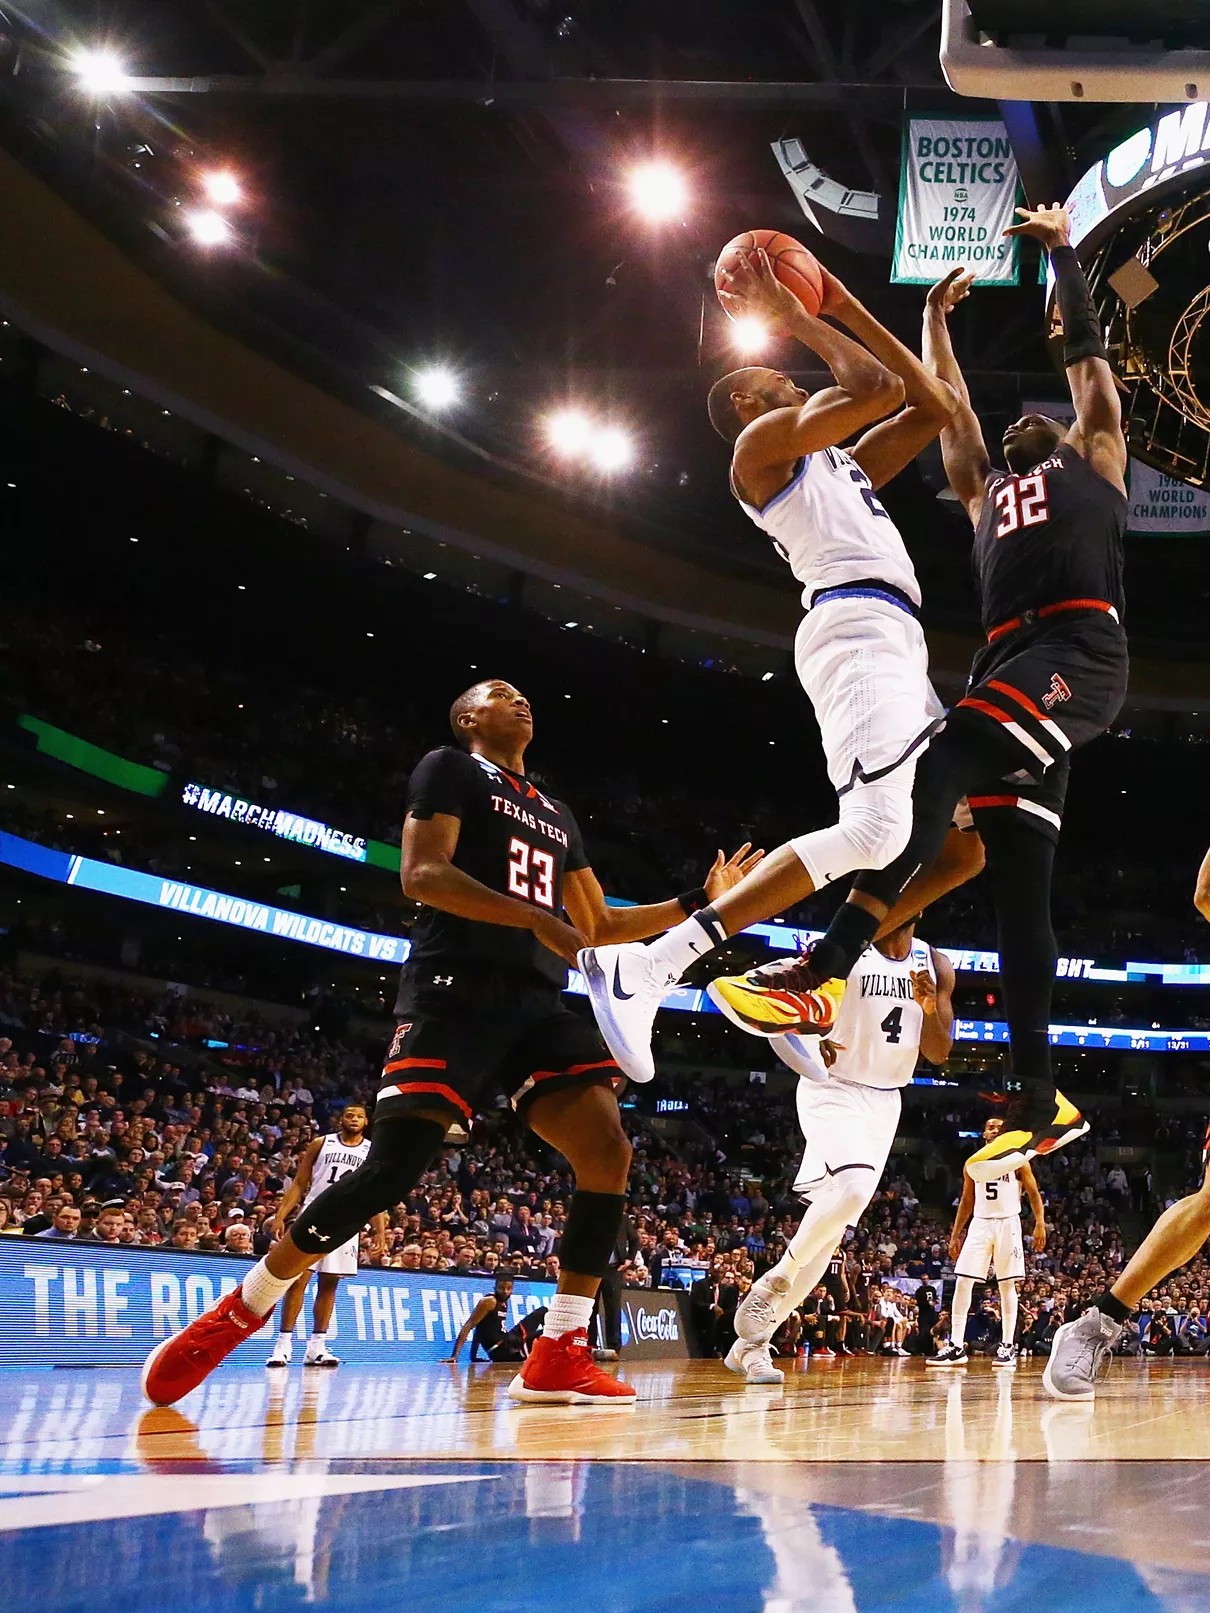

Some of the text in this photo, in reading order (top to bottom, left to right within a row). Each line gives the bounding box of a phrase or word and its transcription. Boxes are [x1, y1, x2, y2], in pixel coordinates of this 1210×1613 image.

[917, 136, 1010, 159] BOSTON
[919, 161, 1005, 184] CELTICS
[943, 206, 976, 222] 1974
[929, 226, 988, 242] WORLD
[908, 243, 1005, 262] CHAMPIONS
[995, 475, 1048, 538] 32
[1149, 490, 1195, 503] WORLD
[1133, 504, 1207, 518] CHAMPIONS
[182, 783, 366, 859] #MARCHMADNESS
[491, 795, 568, 848] TEXAS TECH
[508, 838, 554, 907] 23
[158, 881, 269, 930] VILLANOVA
[273, 910, 364, 954] WILDCATS
[368, 936, 398, 960] VS
[860, 974, 914, 1000] VILLANO
[881, 1006, 903, 1044] 4
[1167, 1040, 1189, 1050] 13/31
[325, 1152, 364, 1168] VILLANOV
[986, 1182, 998, 1200] 5
[24, 1265, 132, 1338] THE
[348, 1284, 415, 1341] THE
[421, 1288, 484, 1342] FIN
